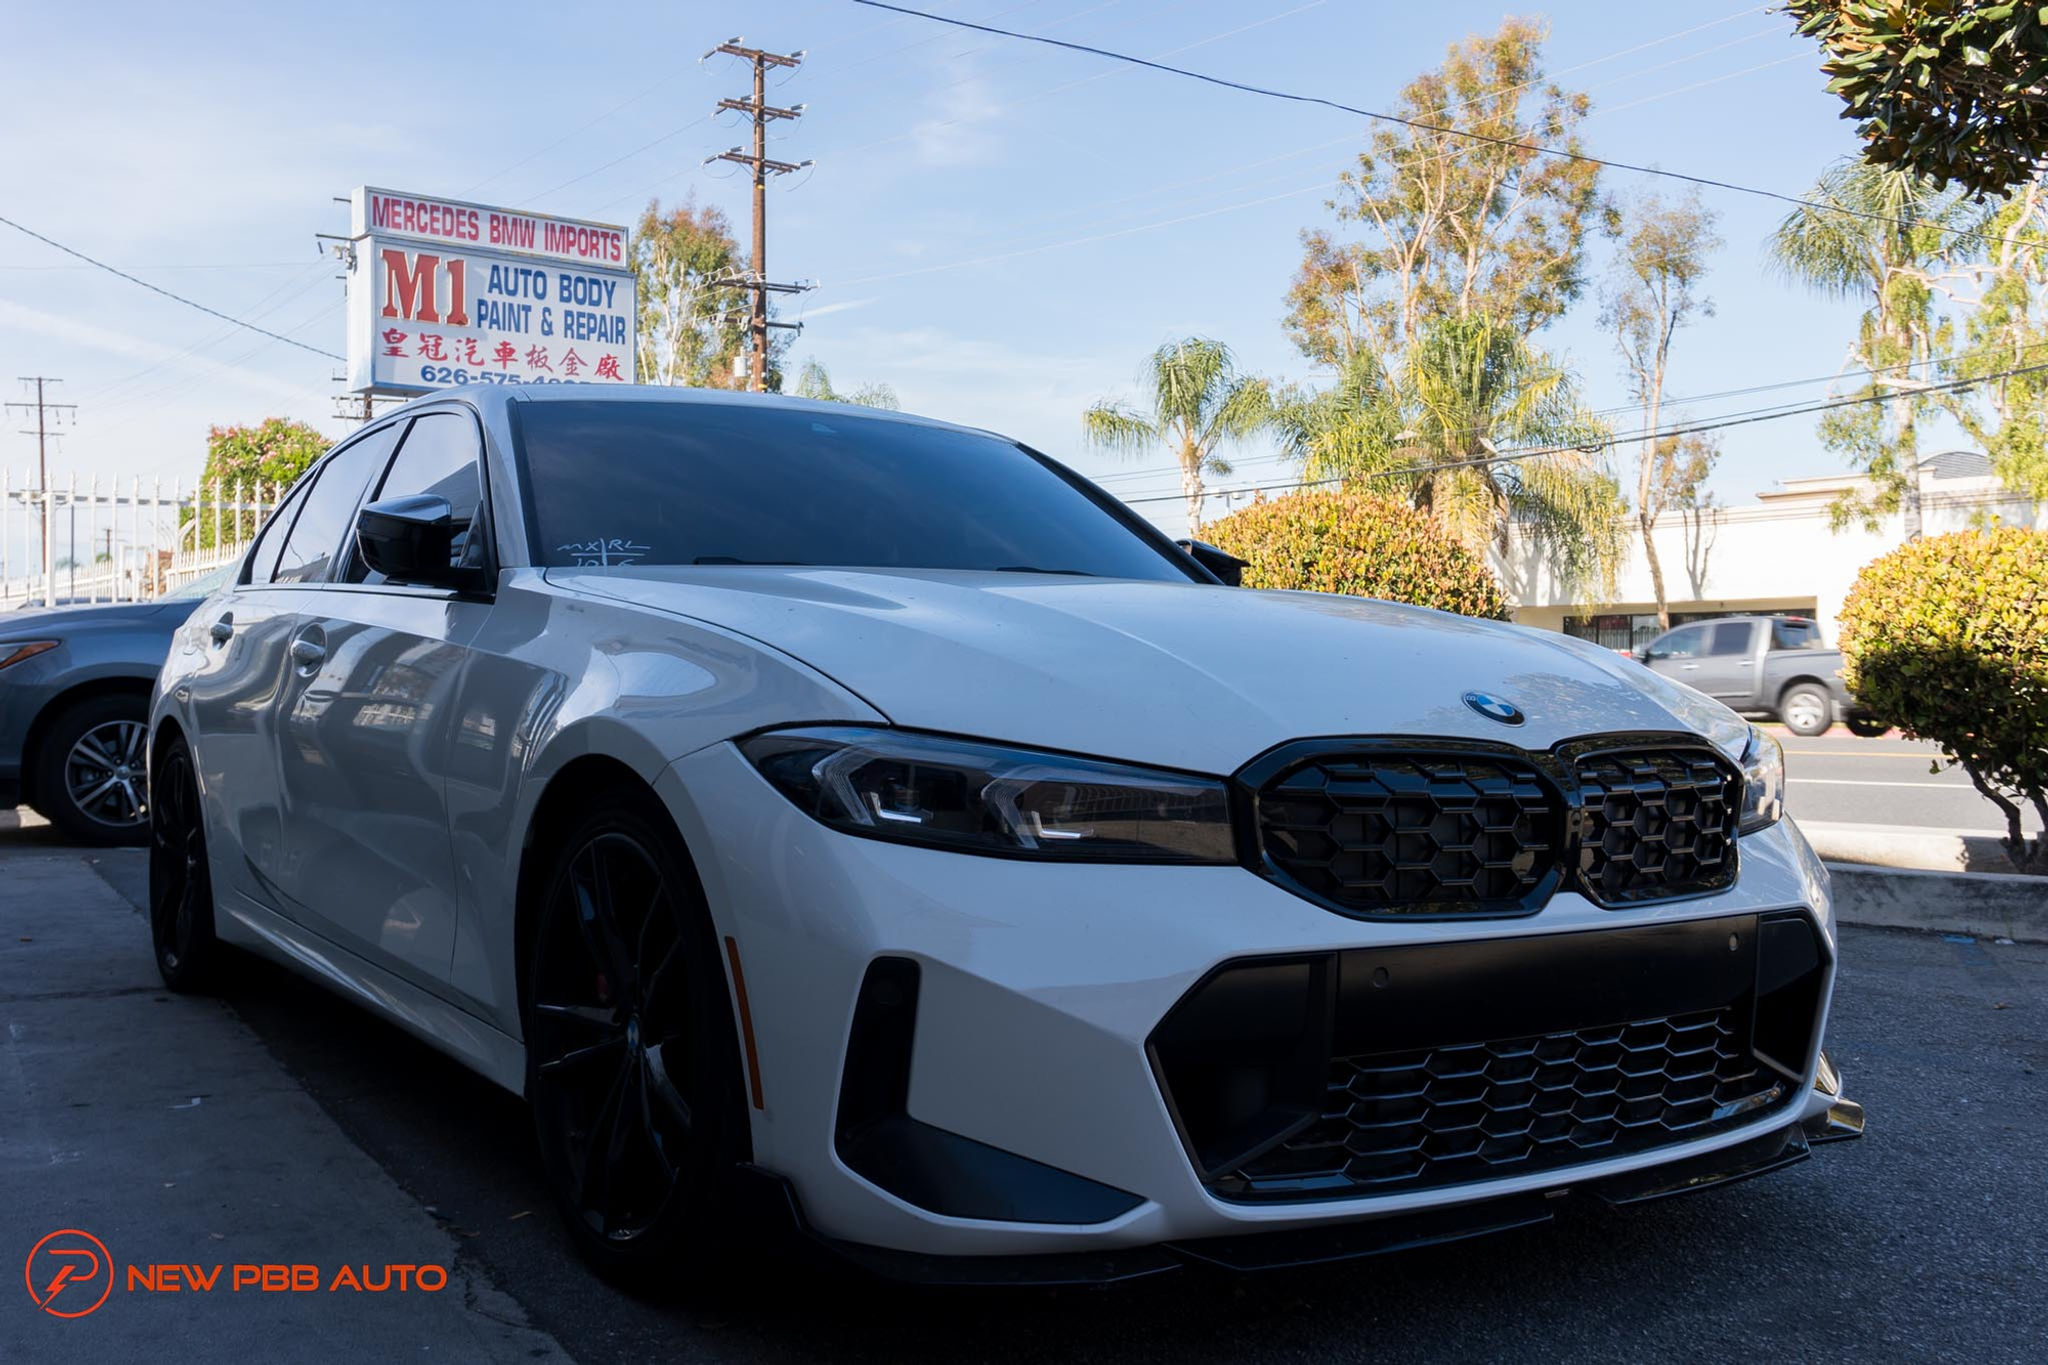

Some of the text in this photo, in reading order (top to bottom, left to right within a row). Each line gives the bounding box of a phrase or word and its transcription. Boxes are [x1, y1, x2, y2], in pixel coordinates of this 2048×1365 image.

[372, 196, 621, 262] MERCEDES BMW IMPORTS
[381, 248, 469, 326] M1
[488, 264, 617, 309] AUTO BODY
[477, 299, 626, 345] PAINT & REPAIR
